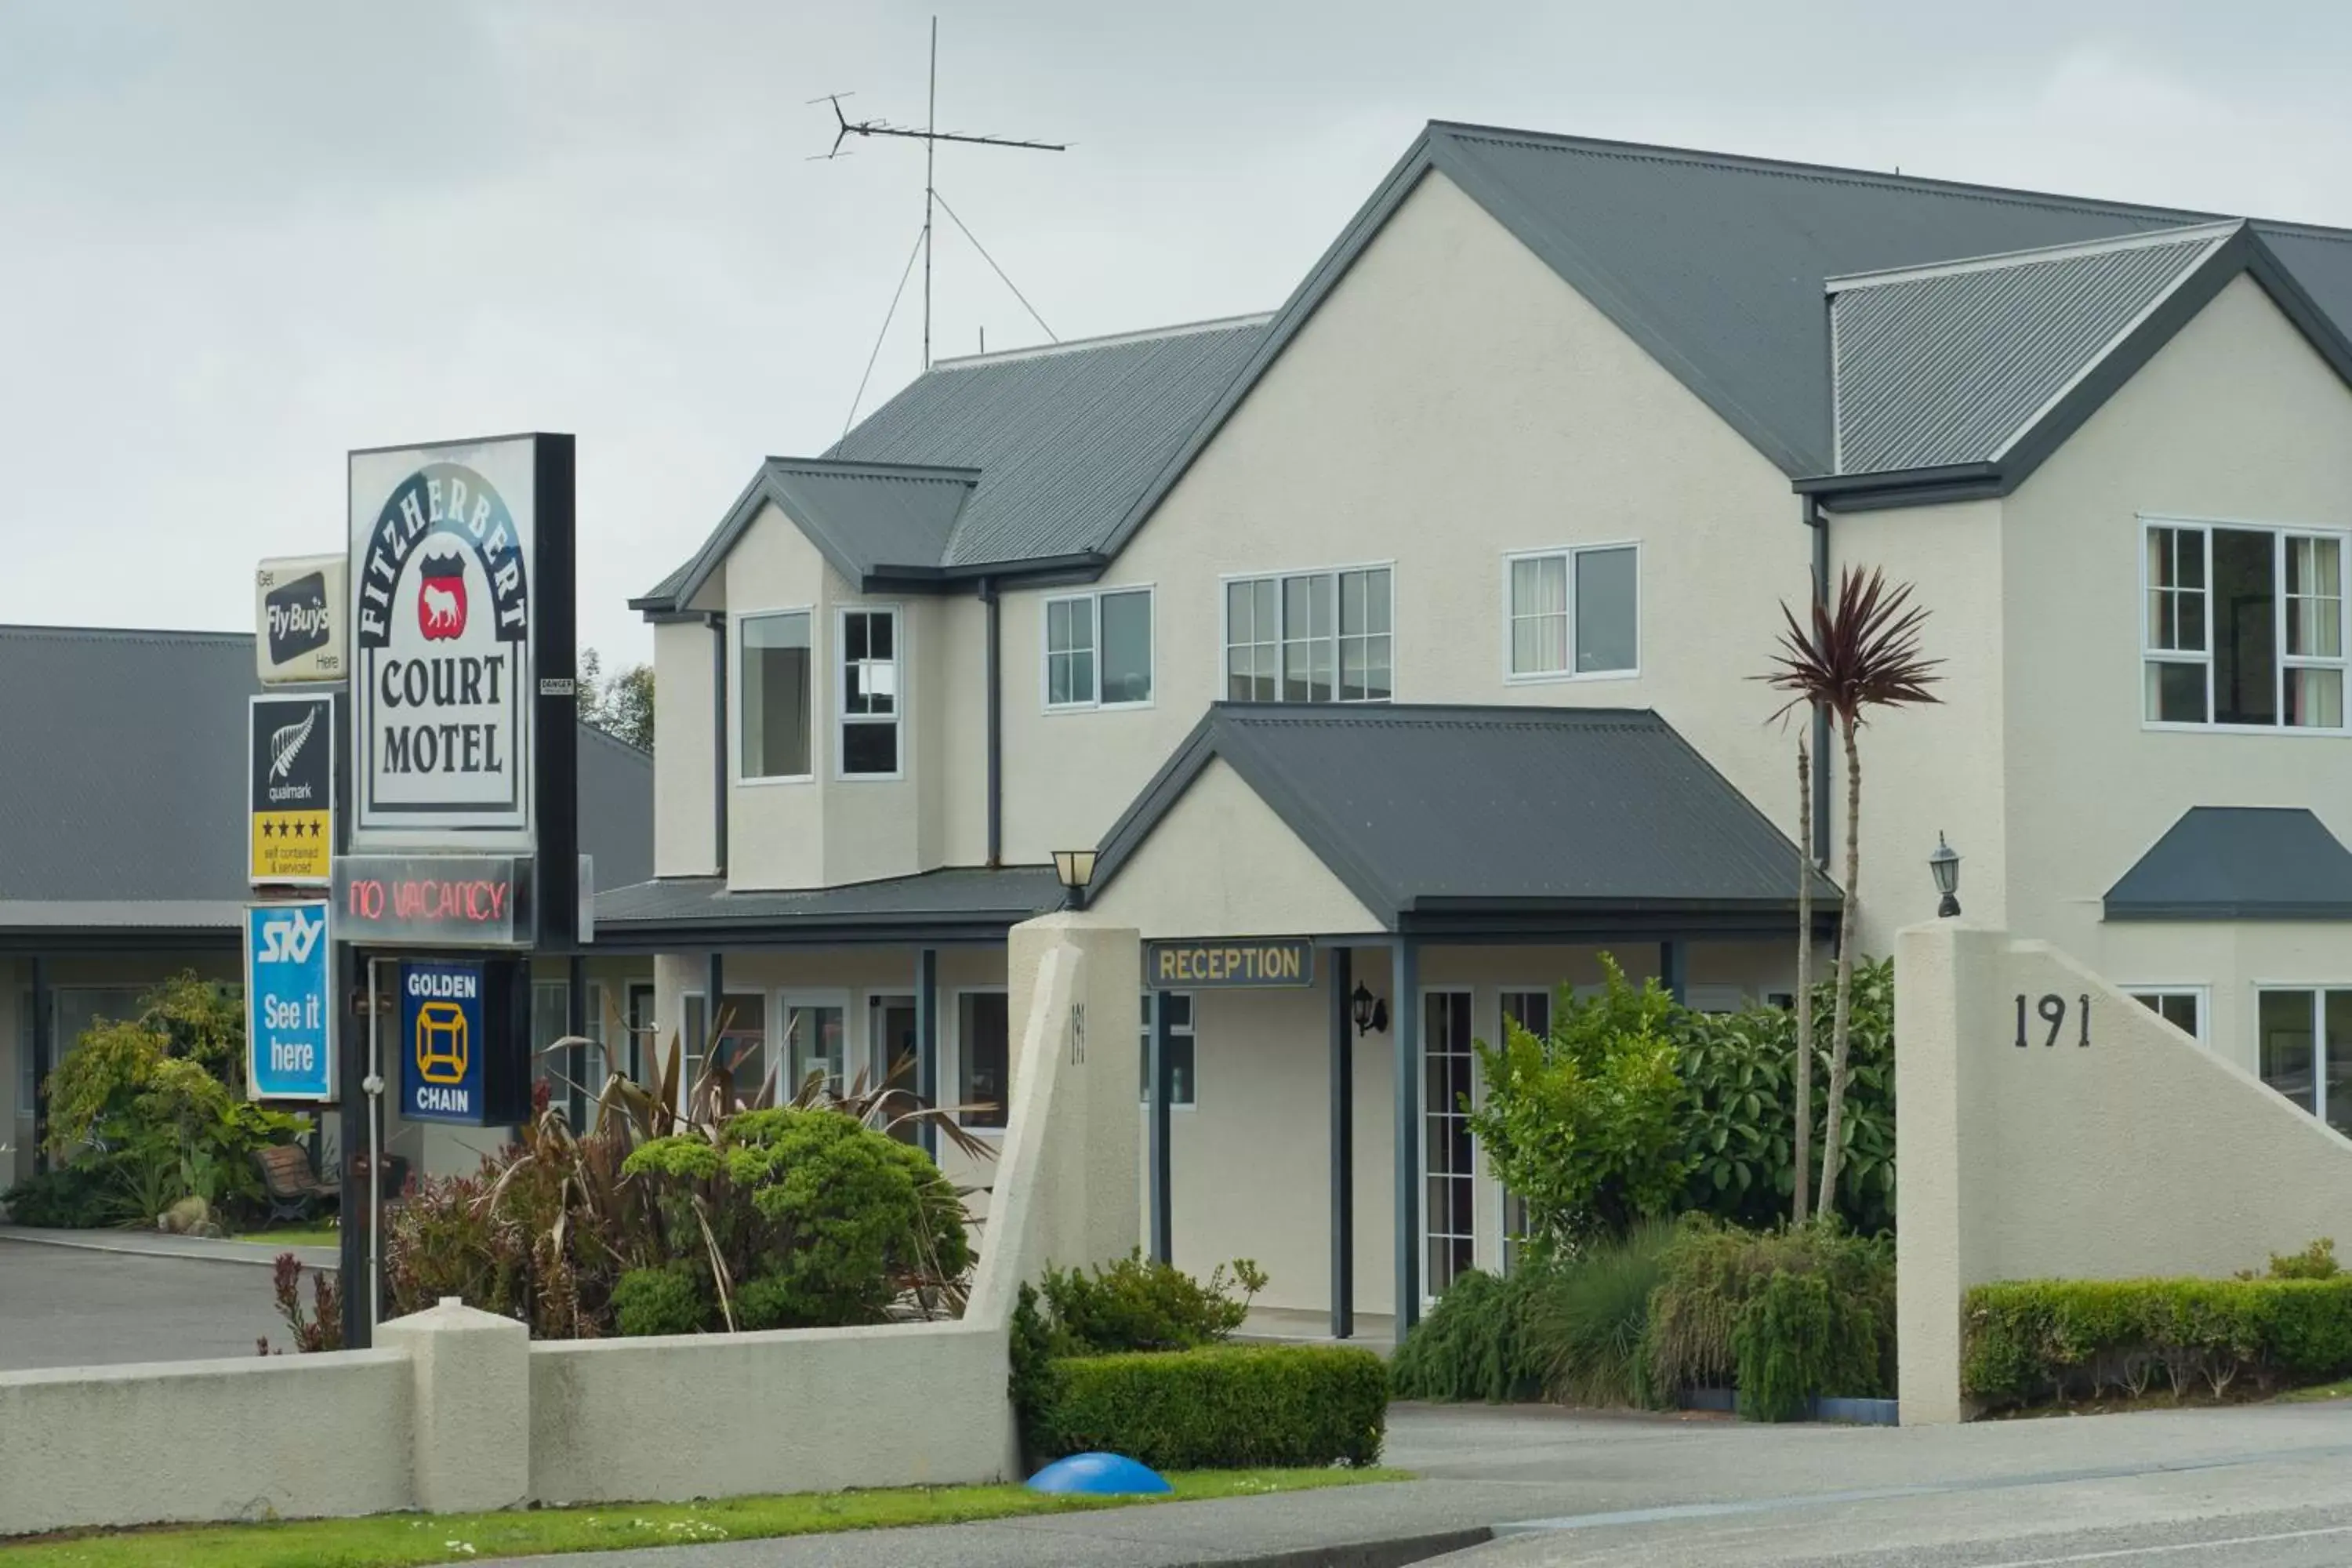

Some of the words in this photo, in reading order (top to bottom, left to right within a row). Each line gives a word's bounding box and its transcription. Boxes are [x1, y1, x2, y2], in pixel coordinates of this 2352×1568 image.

[361, 477, 527, 637] FITZHERBERT
[257, 571, 274, 586] Get
[267, 598, 328, 640] FlyBuys
[316, 654, 339, 670] Here
[382, 655, 504, 706] COURT
[383, 724, 503, 774] MOTEL
[269, 782, 312, 802] qualmark
[350, 880, 384, 920] NO
[394, 880, 506, 921] VACANCY
[259, 909, 325, 964] SKY
[1160, 947, 1300, 980] RECEPTION
[408, 974, 476, 998] GOLDEN
[264, 993, 300, 1029] See
[307, 993, 320, 1029] it
[2014, 993, 2091, 1047] 191
[270, 1036, 314, 1071] here
[417, 1087, 468, 1112] CHAIN
